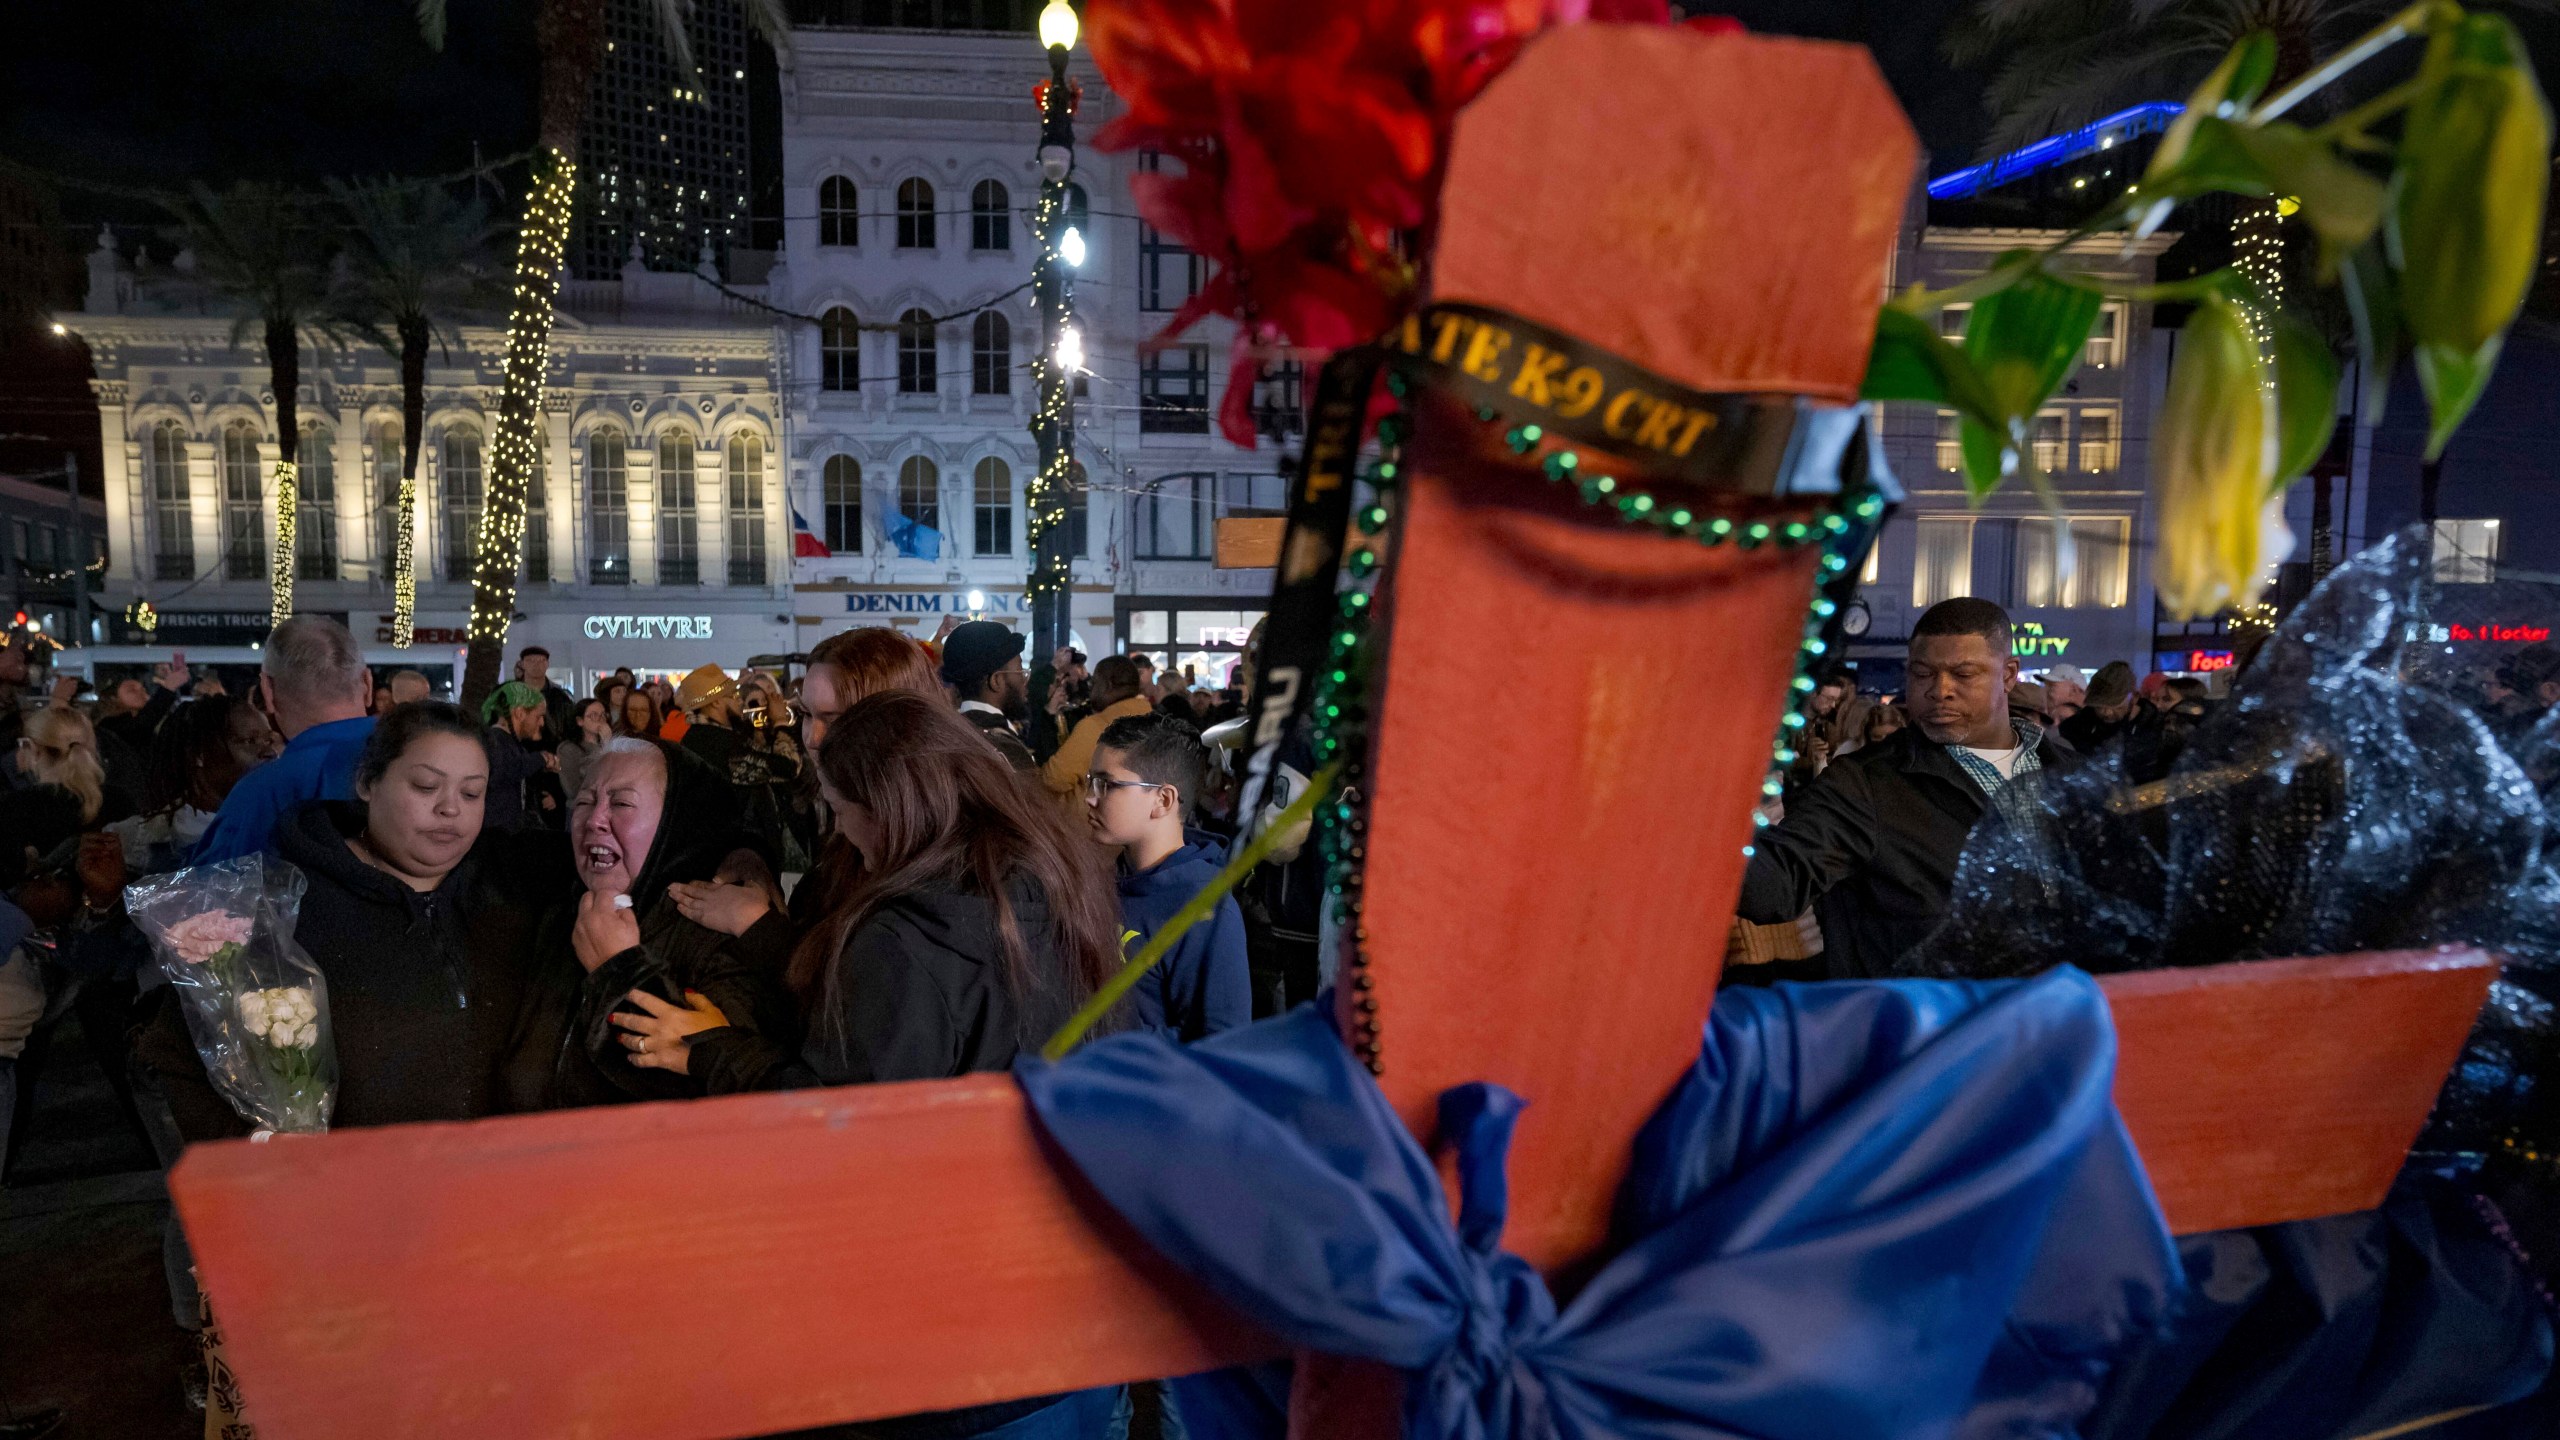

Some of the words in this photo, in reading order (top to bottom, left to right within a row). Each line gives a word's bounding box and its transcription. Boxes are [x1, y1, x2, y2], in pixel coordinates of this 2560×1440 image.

[846, 594, 941, 612] DENIM
[160, 613, 218, 627] FRENCH
[222, 613, 271, 627] TRUCK
[583, 615, 713, 639] CVLTVRE
[376, 628, 467, 643] CMERA
